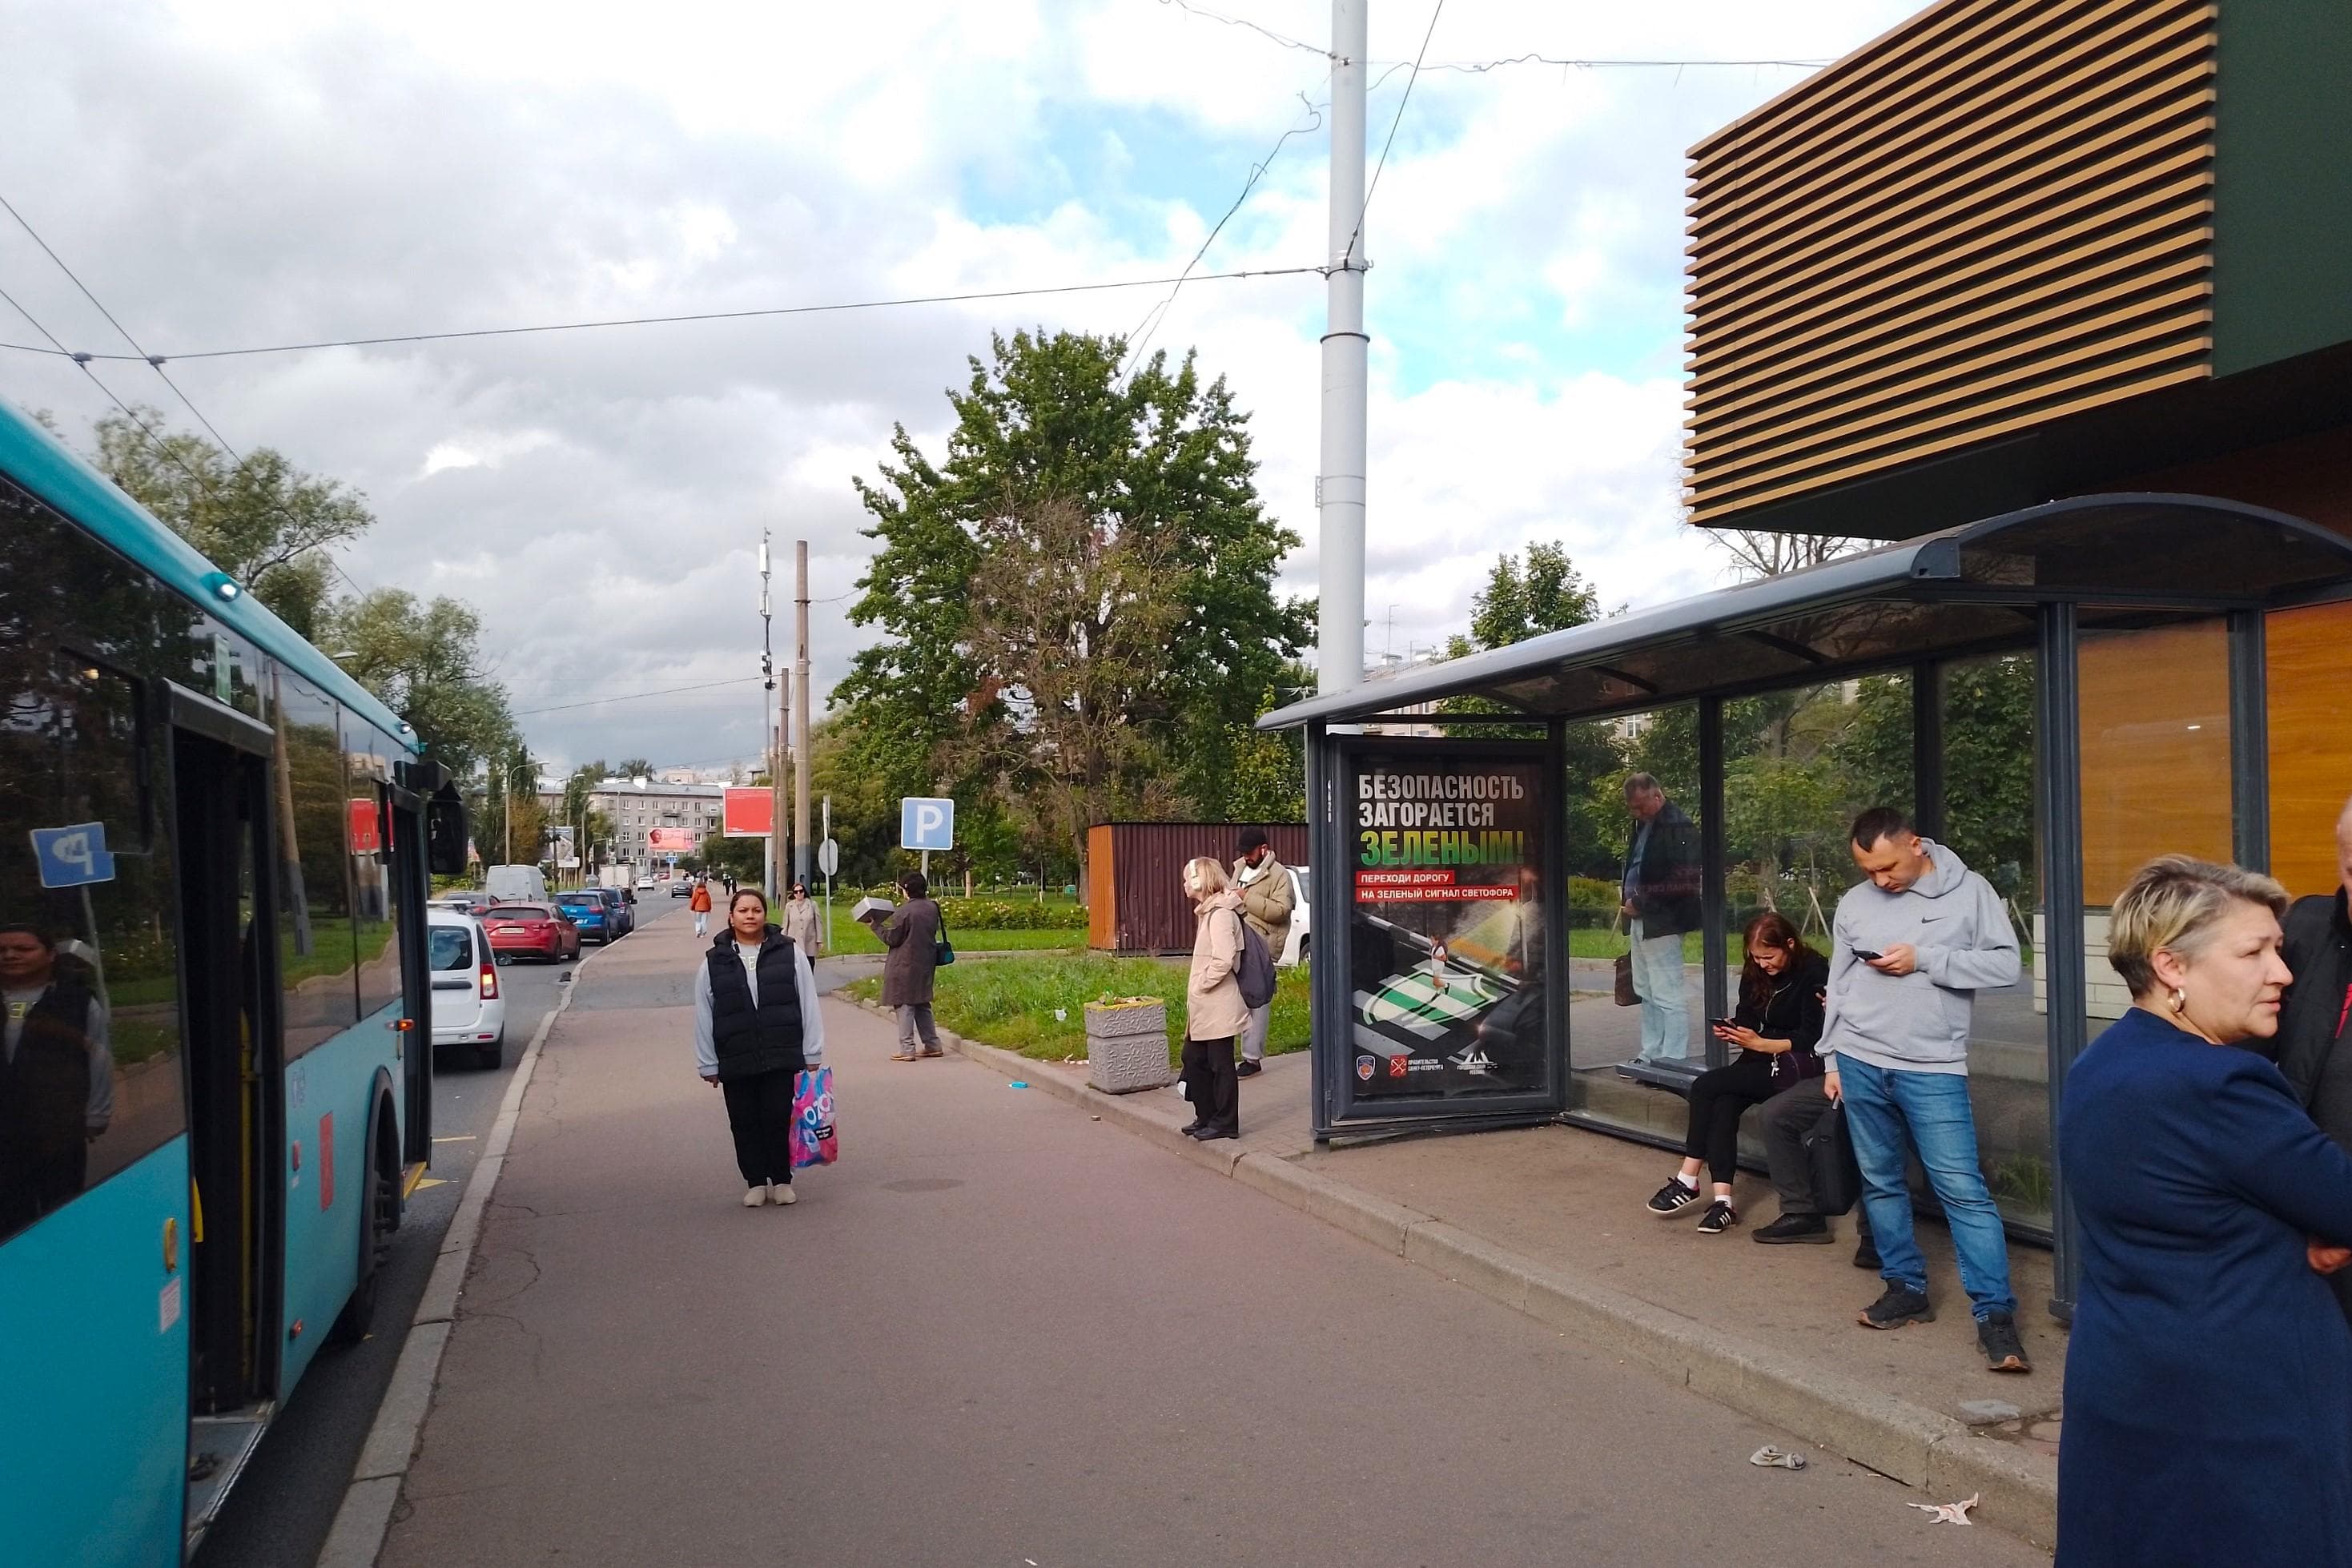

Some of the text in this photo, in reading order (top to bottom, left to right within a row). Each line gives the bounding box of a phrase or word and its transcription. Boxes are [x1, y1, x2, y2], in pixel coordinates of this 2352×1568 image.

[1358, 774, 1525, 799] БЕЗОПАСНОСТЬ
[916, 804, 943, 843] P
[1358, 802, 1495, 827] ЗАГОРАЕТСЯ
[1361, 830, 1524, 866] ЗЕЛЕНЫМ!
[1361, 873, 1449, 884] ПЕРЕХОДИ ДОРОГУ
[1361, 888, 1514, 899] НА ЗЕЛЕНЫЙ СИГНАЛ СВЕТОФОРА
